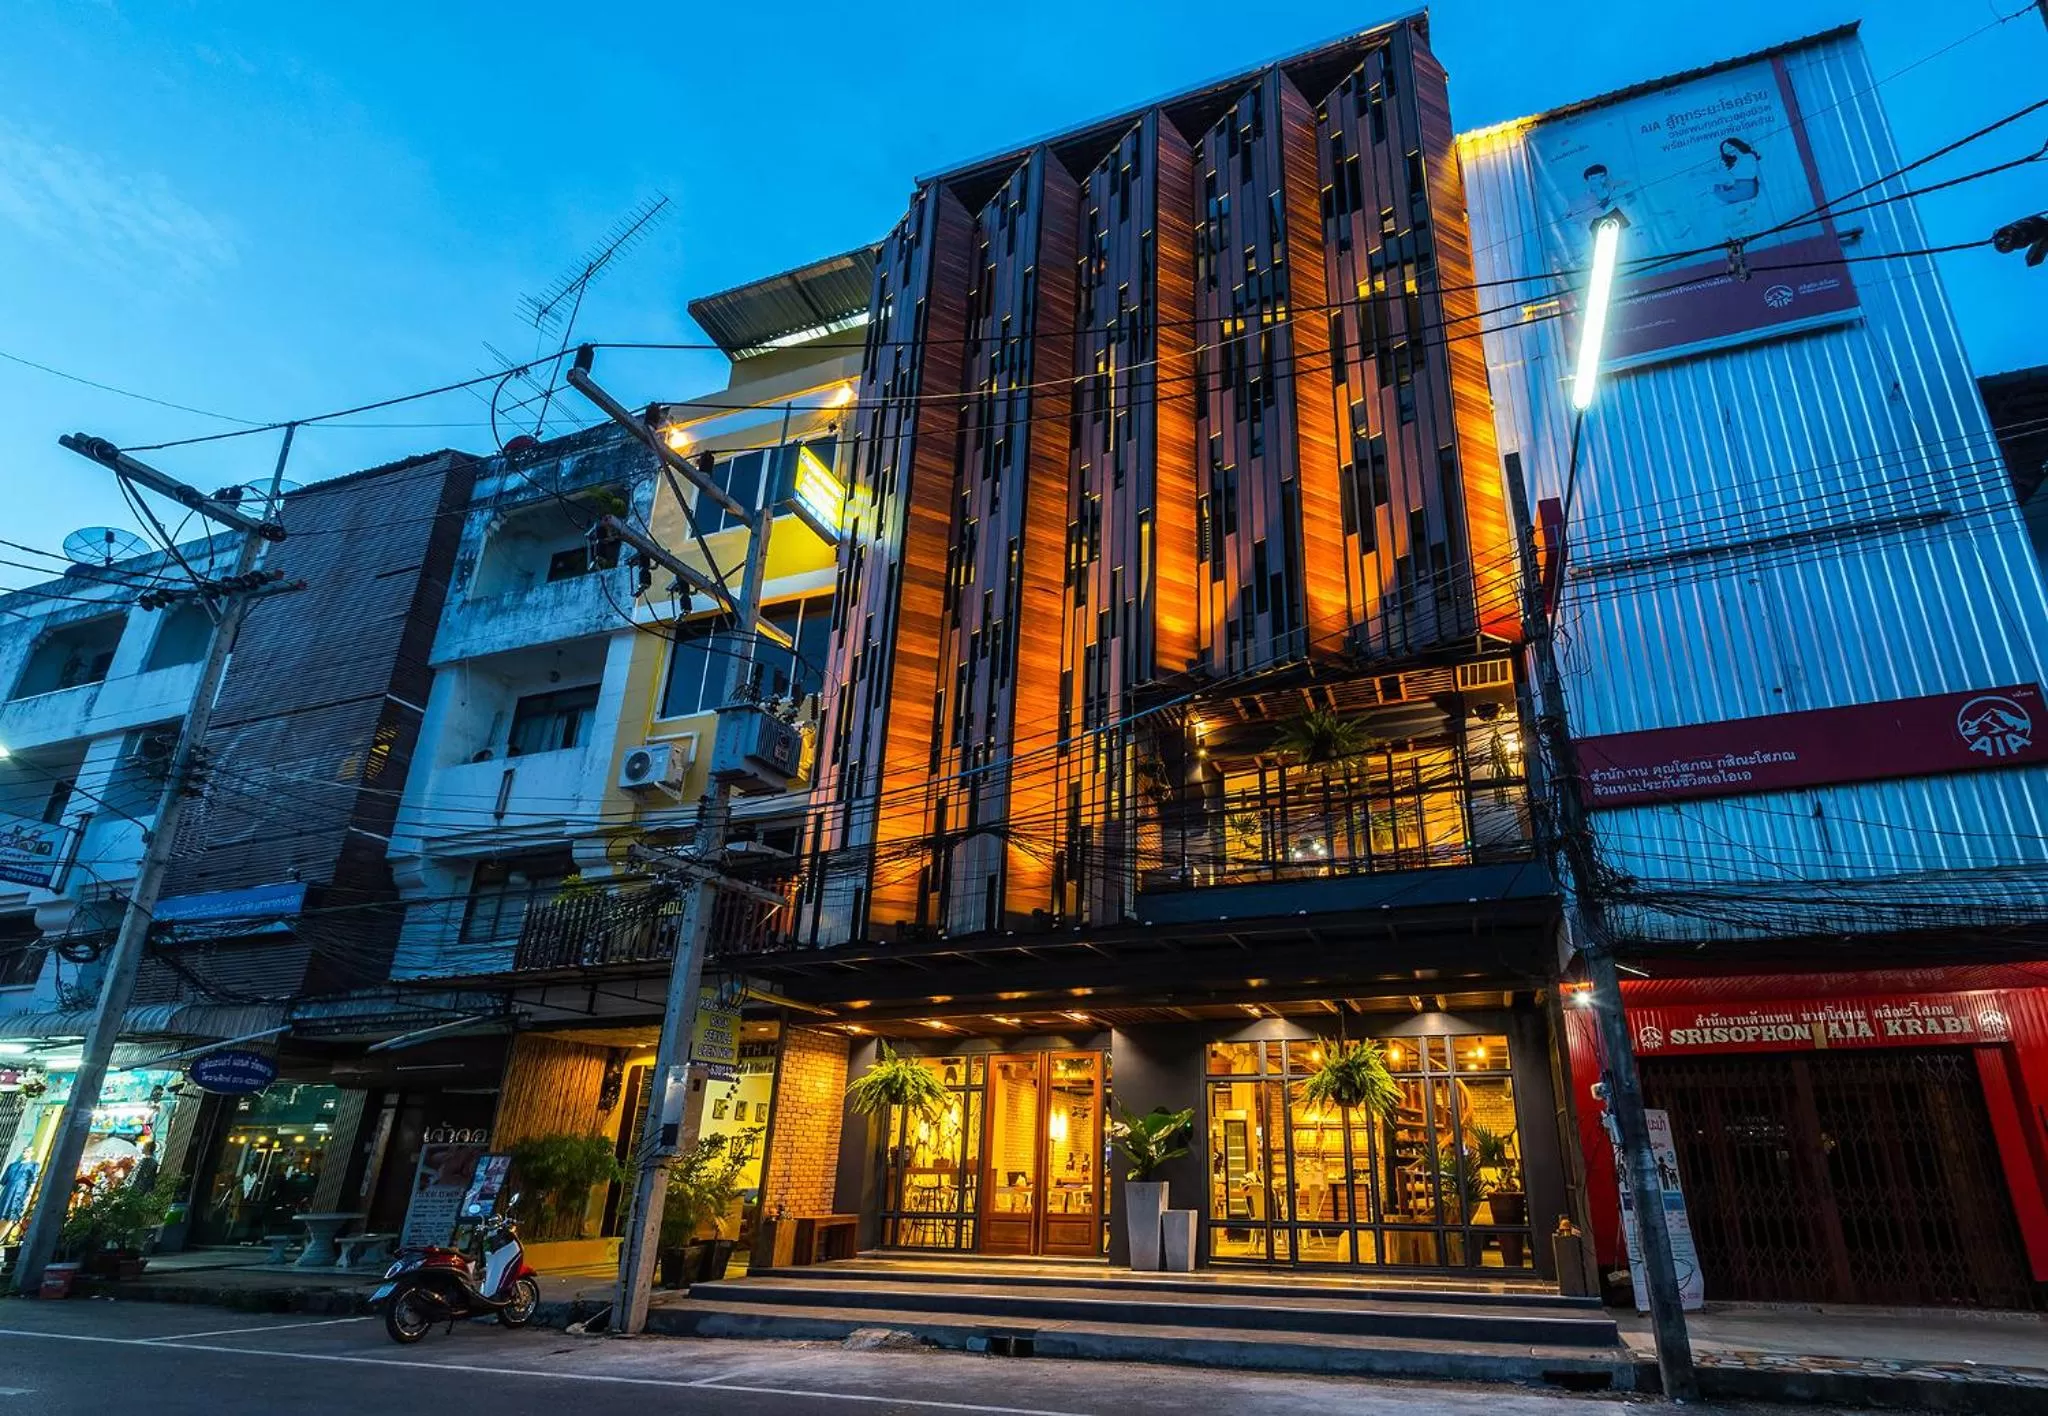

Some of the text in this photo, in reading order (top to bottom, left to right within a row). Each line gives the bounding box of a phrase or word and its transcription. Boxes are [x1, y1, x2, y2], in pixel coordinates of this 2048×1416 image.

[1640, 121, 1661, 135] AIA
[1969, 733, 2032, 757] AIA
[1670, 1014, 1974, 1045] SRISOPHON AIA KRABI
